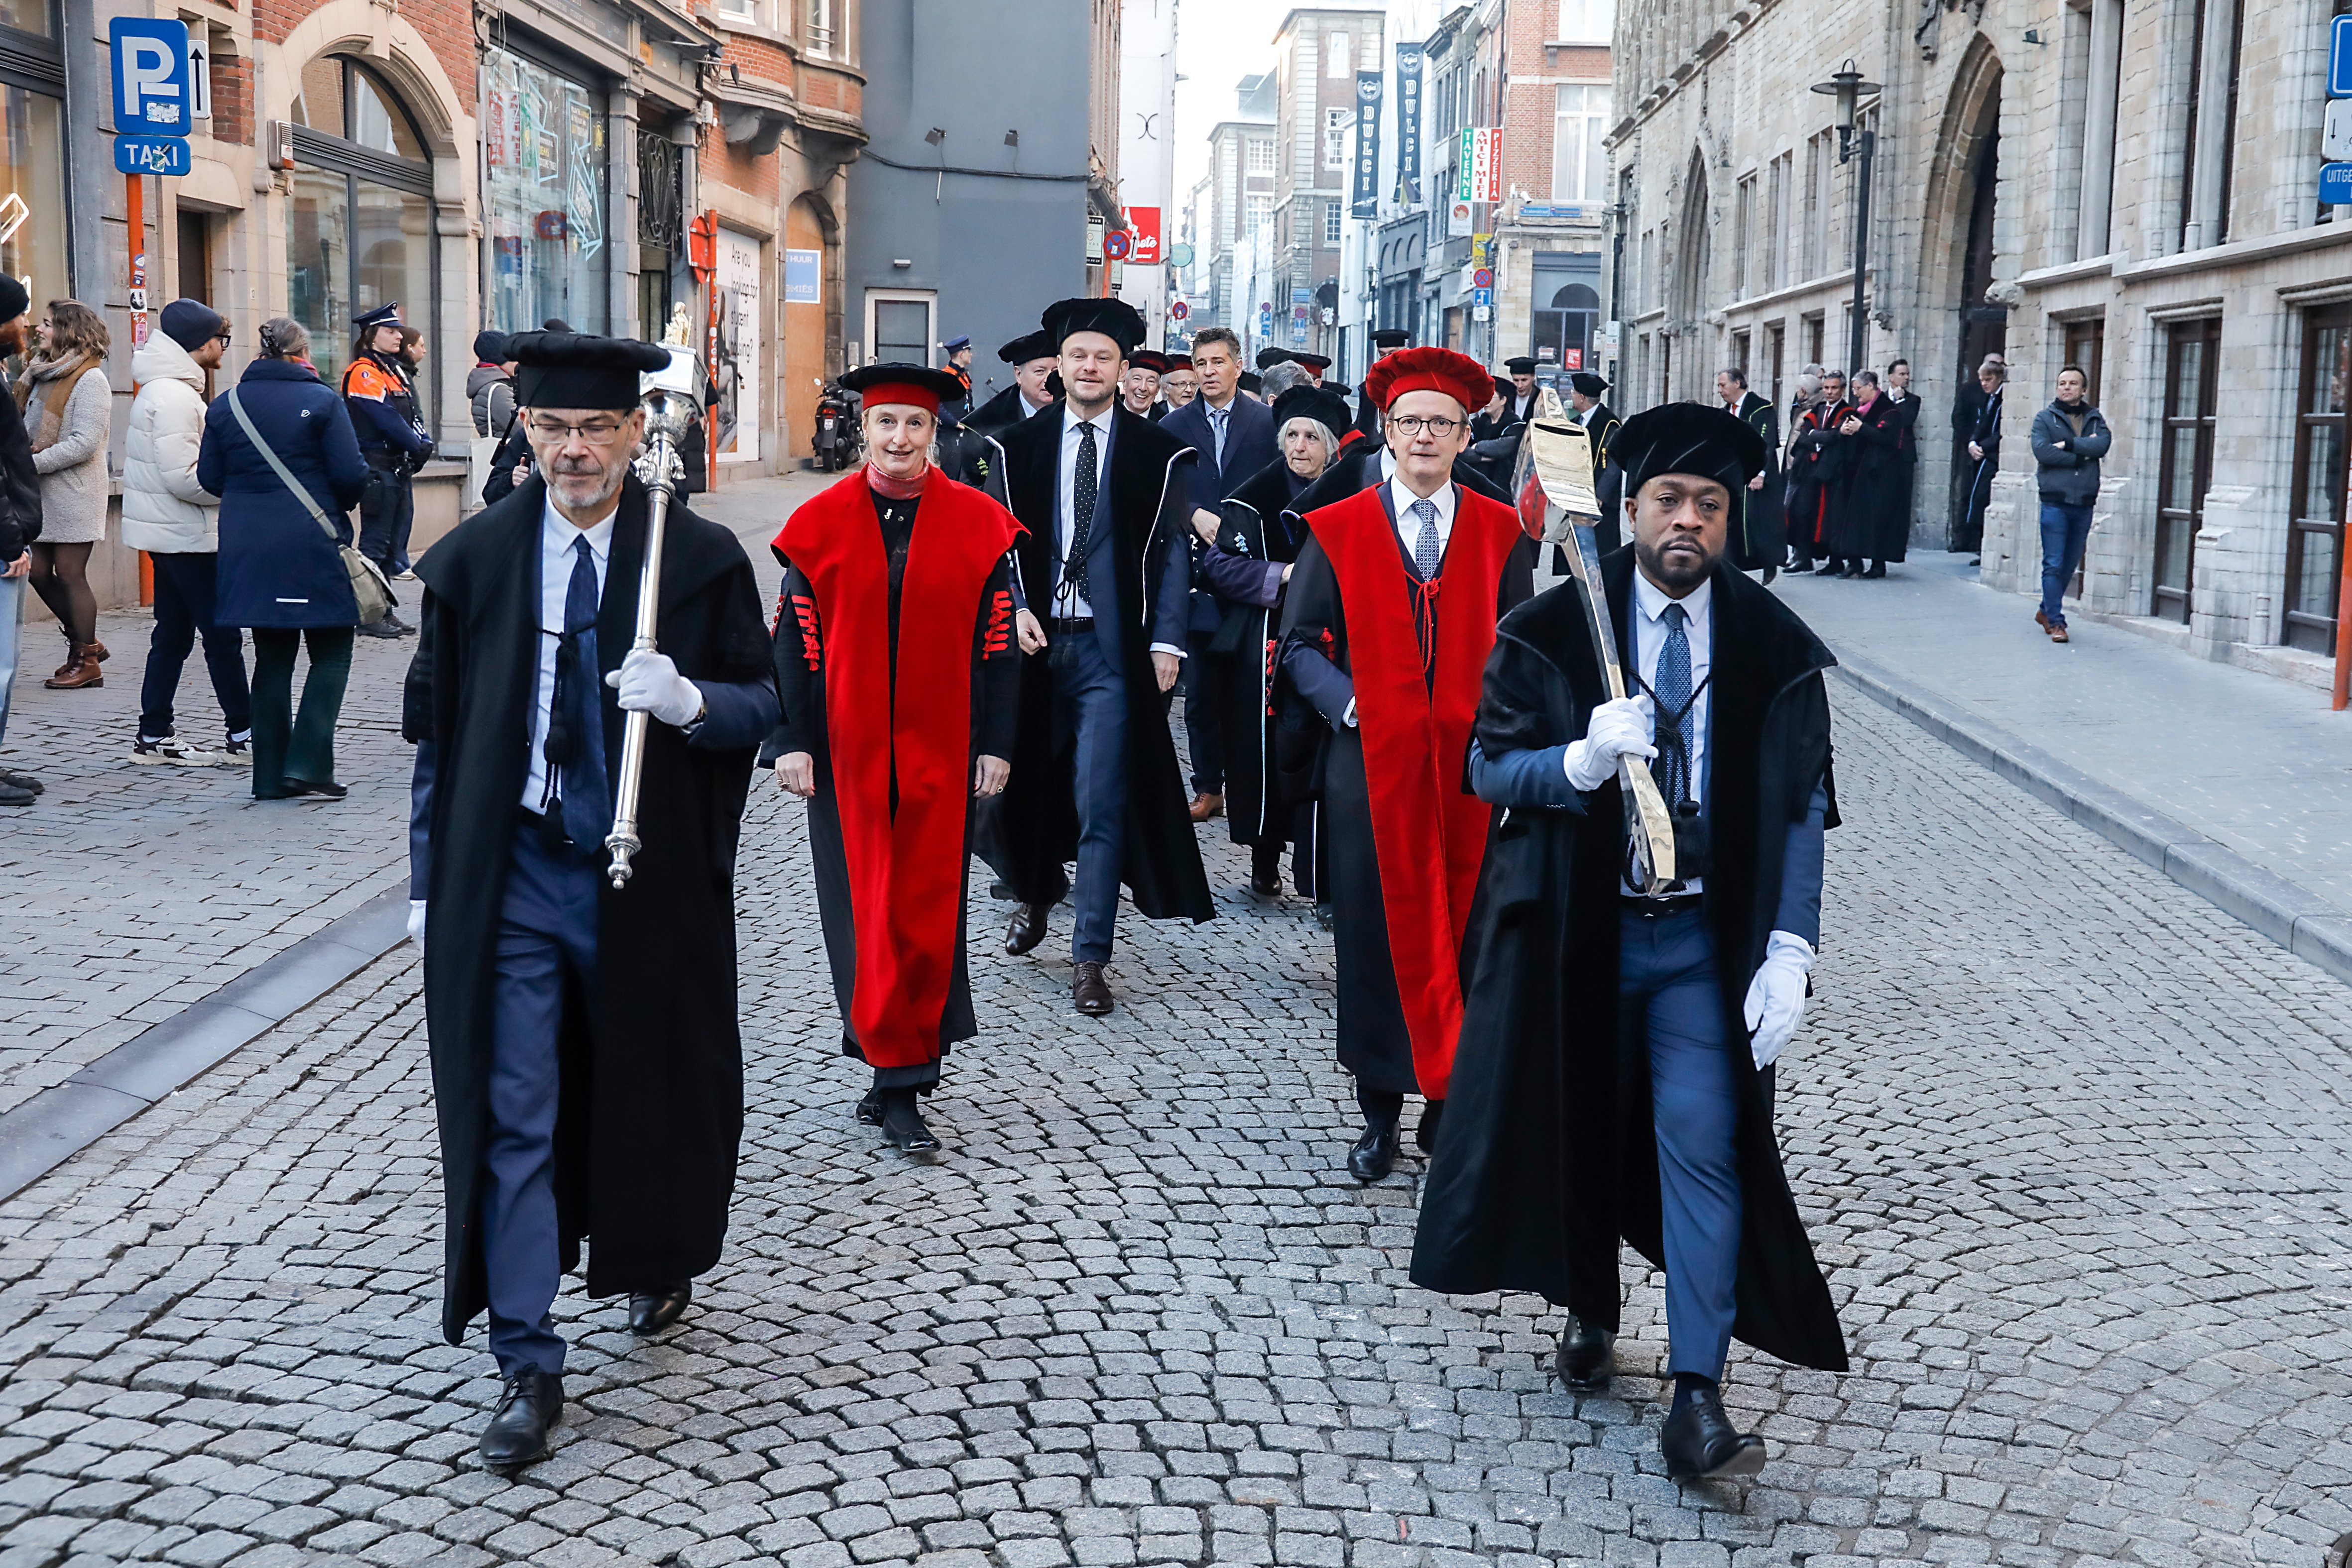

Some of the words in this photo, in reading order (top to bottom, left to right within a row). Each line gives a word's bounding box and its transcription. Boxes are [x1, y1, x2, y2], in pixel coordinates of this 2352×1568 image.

[121, 36, 175, 115] P
[1362, 106, 1375, 191] DULCI
[1405, 80, 1417, 171] DULCI
[1476, 131, 1488, 167] AMICI
[1462, 132, 1471, 197] TAVERNE
[1475, 170, 1487, 199] MIEI
[1490, 132, 1500, 198] PIZZERIA
[731, 243, 740, 265] Are
[741, 251, 751, 272] you
[790, 255, 813, 263] HUUR
[731, 272, 749, 303] looking
